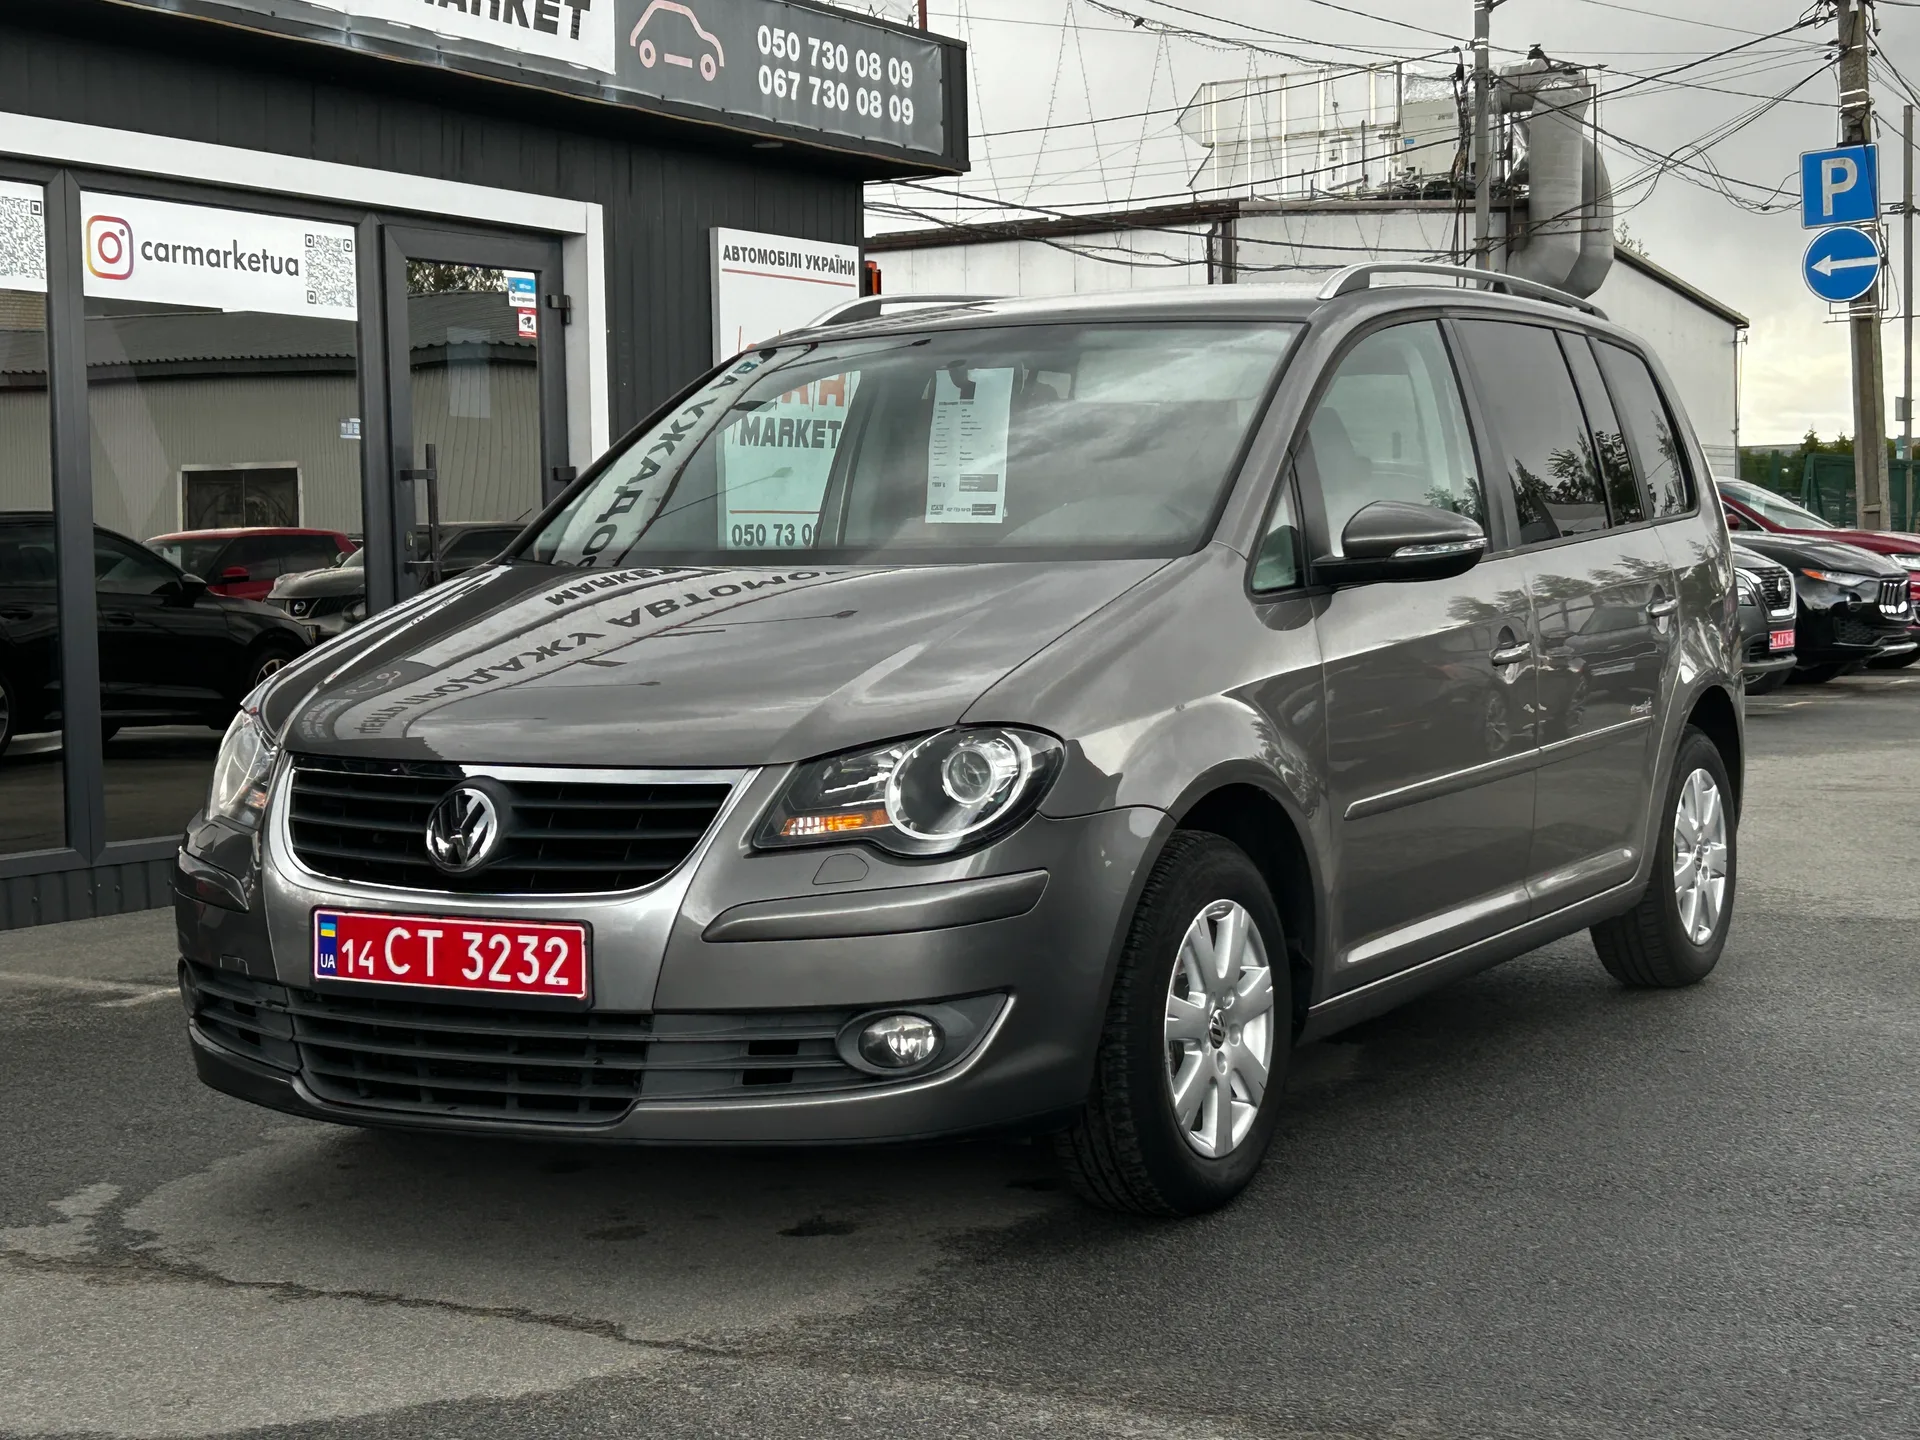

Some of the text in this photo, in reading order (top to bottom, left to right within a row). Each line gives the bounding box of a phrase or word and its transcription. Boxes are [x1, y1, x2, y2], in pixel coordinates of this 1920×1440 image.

[757, 25, 913, 88] 050 730 08 09
[758, 65, 914, 126] 067 730 08 09
[1821, 157, 1858, 216] P
[141, 239, 299, 276] carmarketua
[723, 244, 856, 276] АВТОМОБІЛІ УКРАЇНИ
[740, 416, 842, 449] MARKET
[732, 523, 766, 546] 050
[773, 523, 795, 546] 73
[320, 953, 336, 969] UA
[462, 932, 569, 986] 3232
